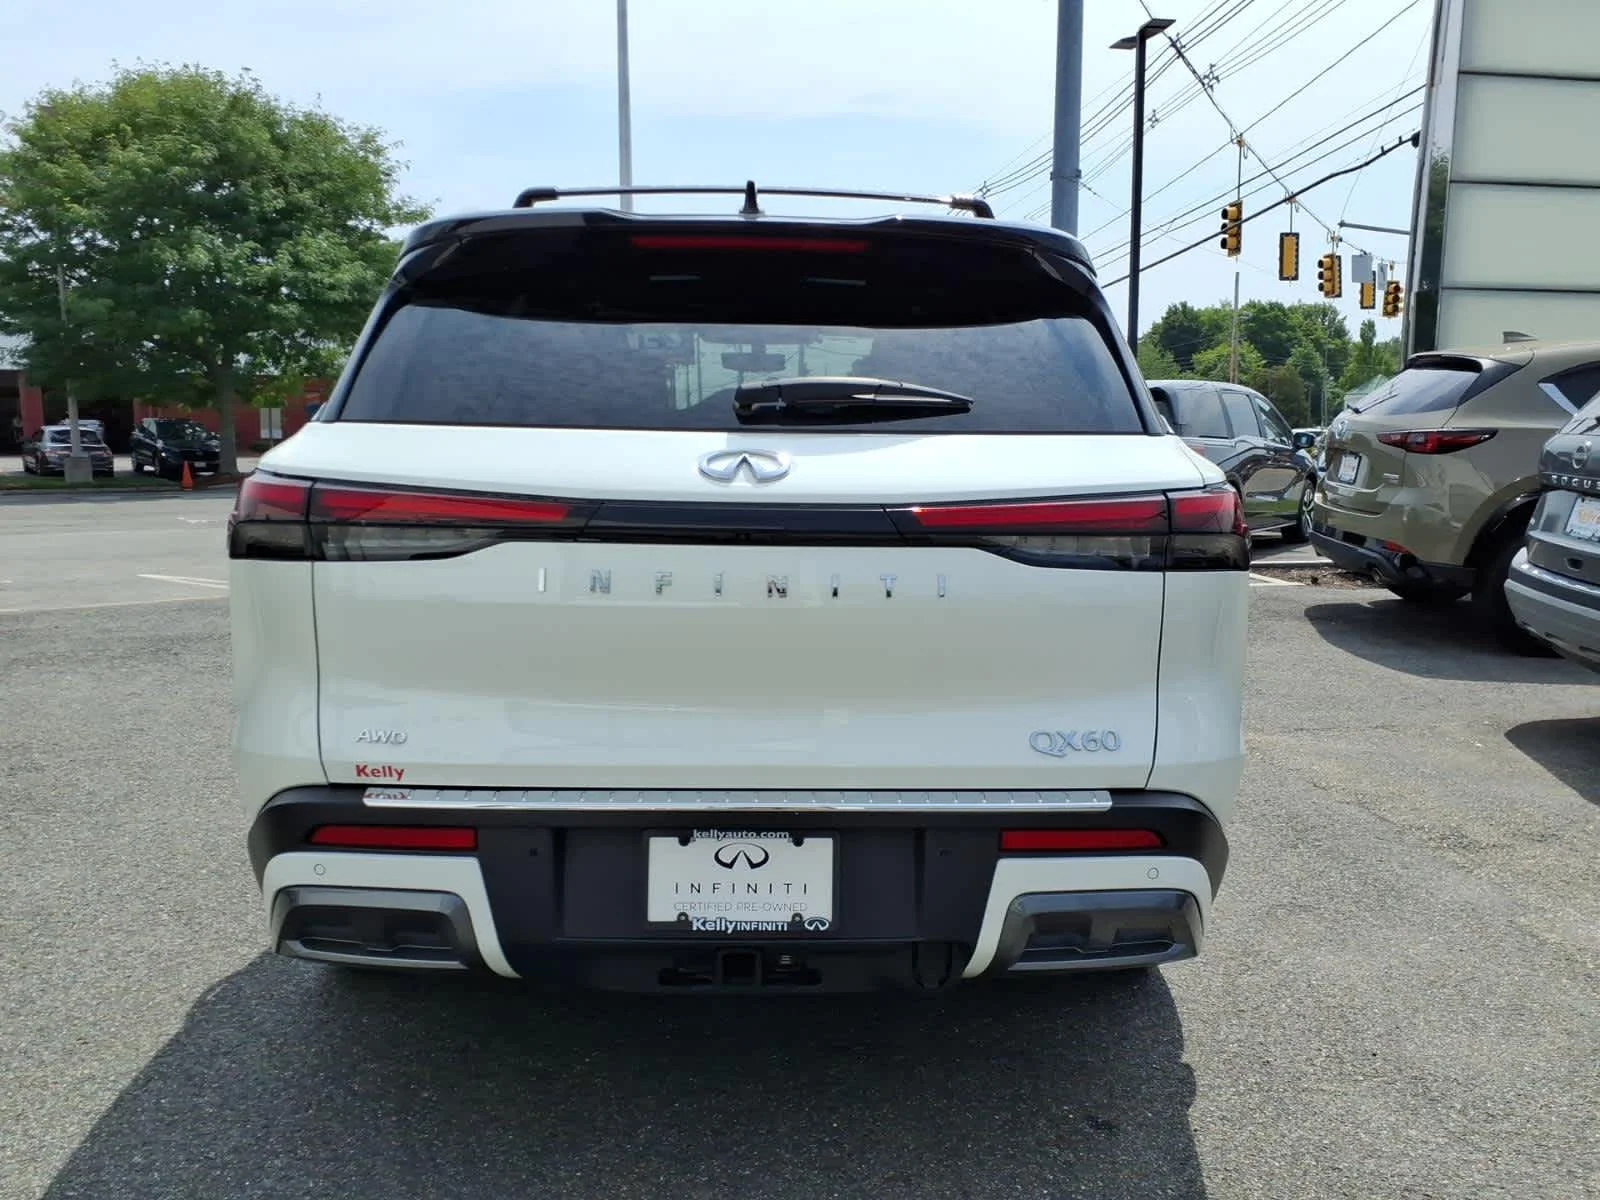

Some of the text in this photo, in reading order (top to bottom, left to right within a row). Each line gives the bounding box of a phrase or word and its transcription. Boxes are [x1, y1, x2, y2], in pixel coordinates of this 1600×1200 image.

[538, 567, 946, 599] INFINITI
[355, 728, 408, 745] AWD
[1029, 729, 1121, 758] QX60
[355, 764, 405, 781] Kelly
[692, 829, 790, 841] kellyauto.com
[673, 882, 808, 894] INFINITI
[673, 902, 808, 912] CERTIFIED PRE-OWNED
